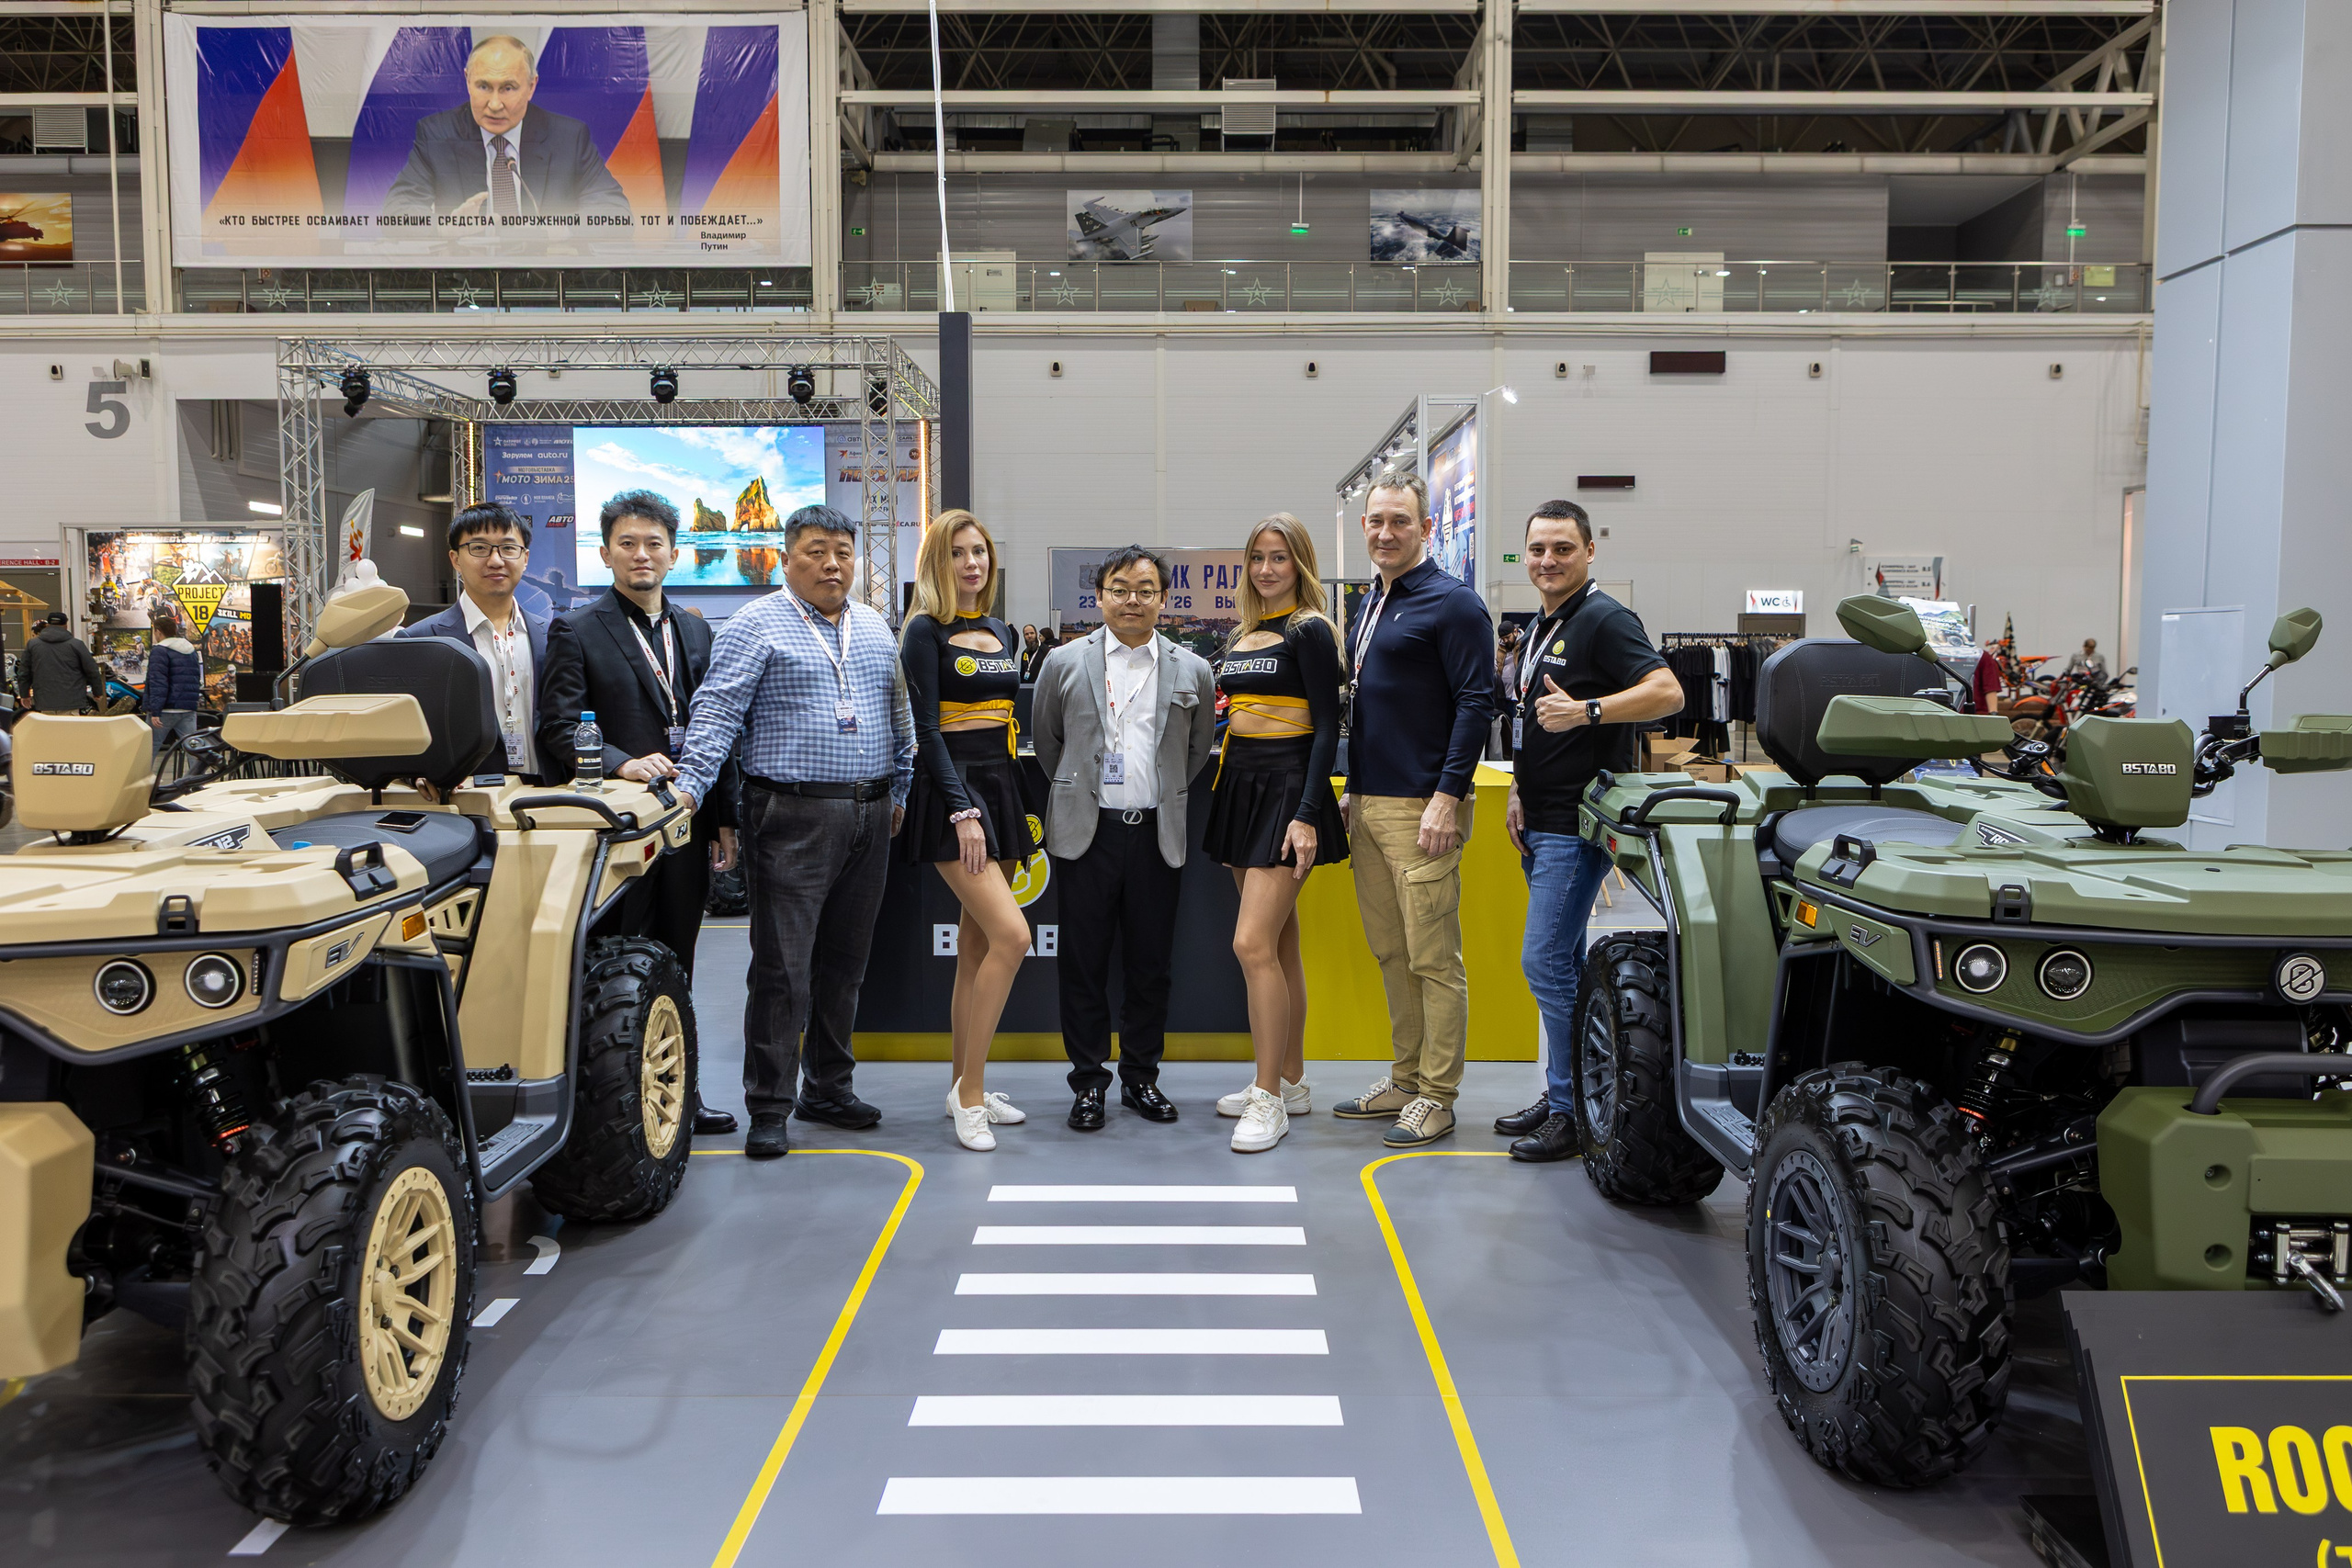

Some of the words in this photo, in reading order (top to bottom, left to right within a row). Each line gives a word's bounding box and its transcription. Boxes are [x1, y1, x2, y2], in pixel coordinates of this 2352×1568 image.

[219, 214, 245, 226] «КТО
[252, 214, 300, 226] БЫСТРЕЕ
[307, 214, 369, 226] ОСВАИВАЕТ
[376, 213, 432, 226] НОВЕЙШИЕ
[438, 215, 495, 227] СРЕДСТВА
[502, 213, 581, 226] ВООРУЖЕННОЙ
[640, 215, 661, 226] ТОТ
[667, 215, 674, 226] И
[701, 231, 747, 241] Владимир
[701, 243, 729, 253] Путин
[85, 381, 130, 438] 5
[178, 587, 225, 599] PROJECT
[1760, 597, 1781, 606] WC
[192, 605, 209, 621] 18
[217, 608, 239, 619] SKILL
[1221, 658, 1278, 675] BSTABO
[33, 762, 95, 775] BSTABO
[2121, 762, 2177, 774] BSTABO
